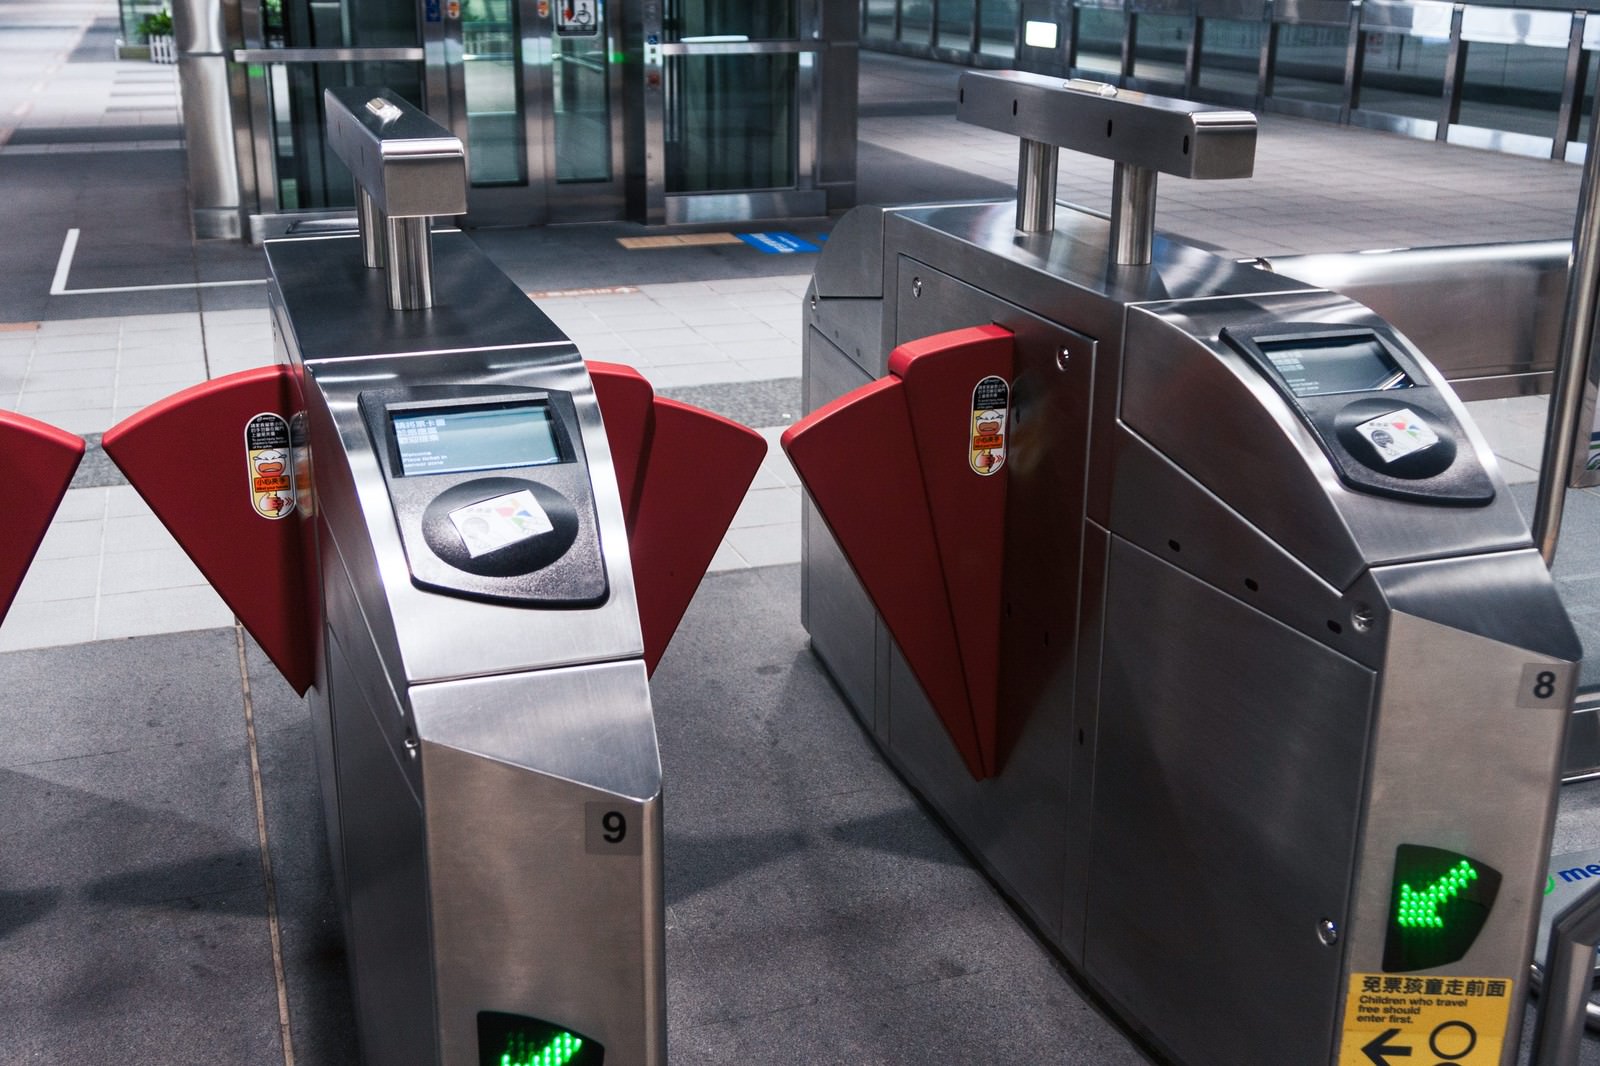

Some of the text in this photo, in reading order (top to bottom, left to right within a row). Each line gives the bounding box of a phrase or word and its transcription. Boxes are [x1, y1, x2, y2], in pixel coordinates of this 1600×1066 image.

[1533, 671, 1556, 699] 8
[602, 811, 626, 844] 9
[1361, 976, 1507, 997] 免票孩童走前面
[1359, 994, 1468, 1007] Children who travel
[1358, 1005, 1421, 1014] free should
[1356, 1015, 1414, 1024] enter first.
